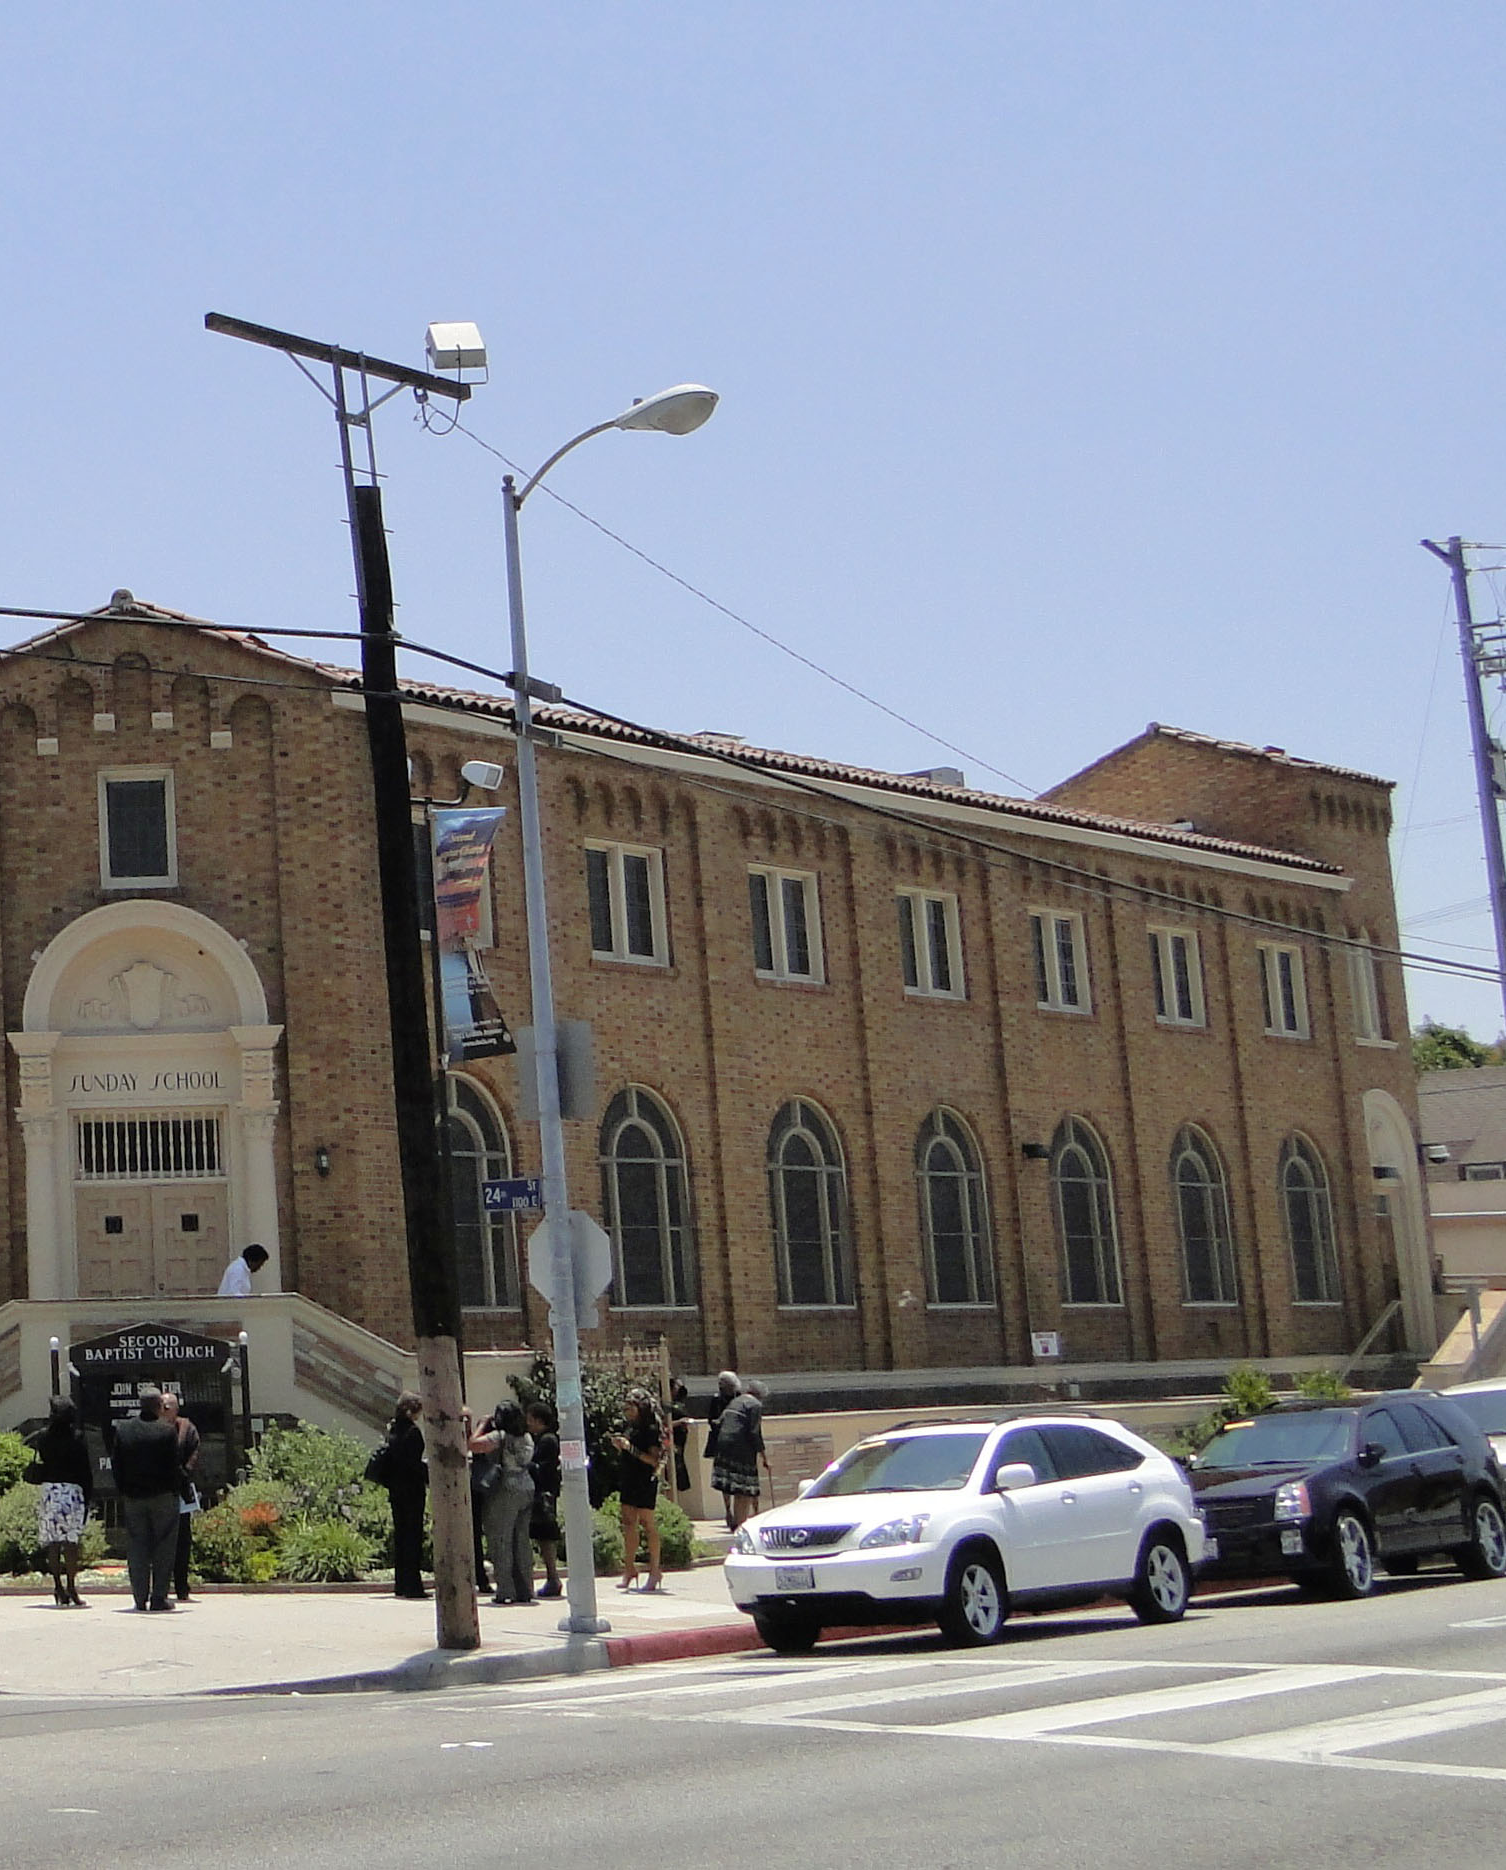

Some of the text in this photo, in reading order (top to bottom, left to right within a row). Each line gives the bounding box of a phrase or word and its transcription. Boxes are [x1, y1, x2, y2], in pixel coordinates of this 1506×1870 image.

[67, 1071, 226, 1092] SUNDAY SCHOOL
[118, 1335, 179, 1348] SECOND
[85, 1345, 215, 1361] BAPTIST CHURCH
[110, 1382, 132, 1396] JOIN
